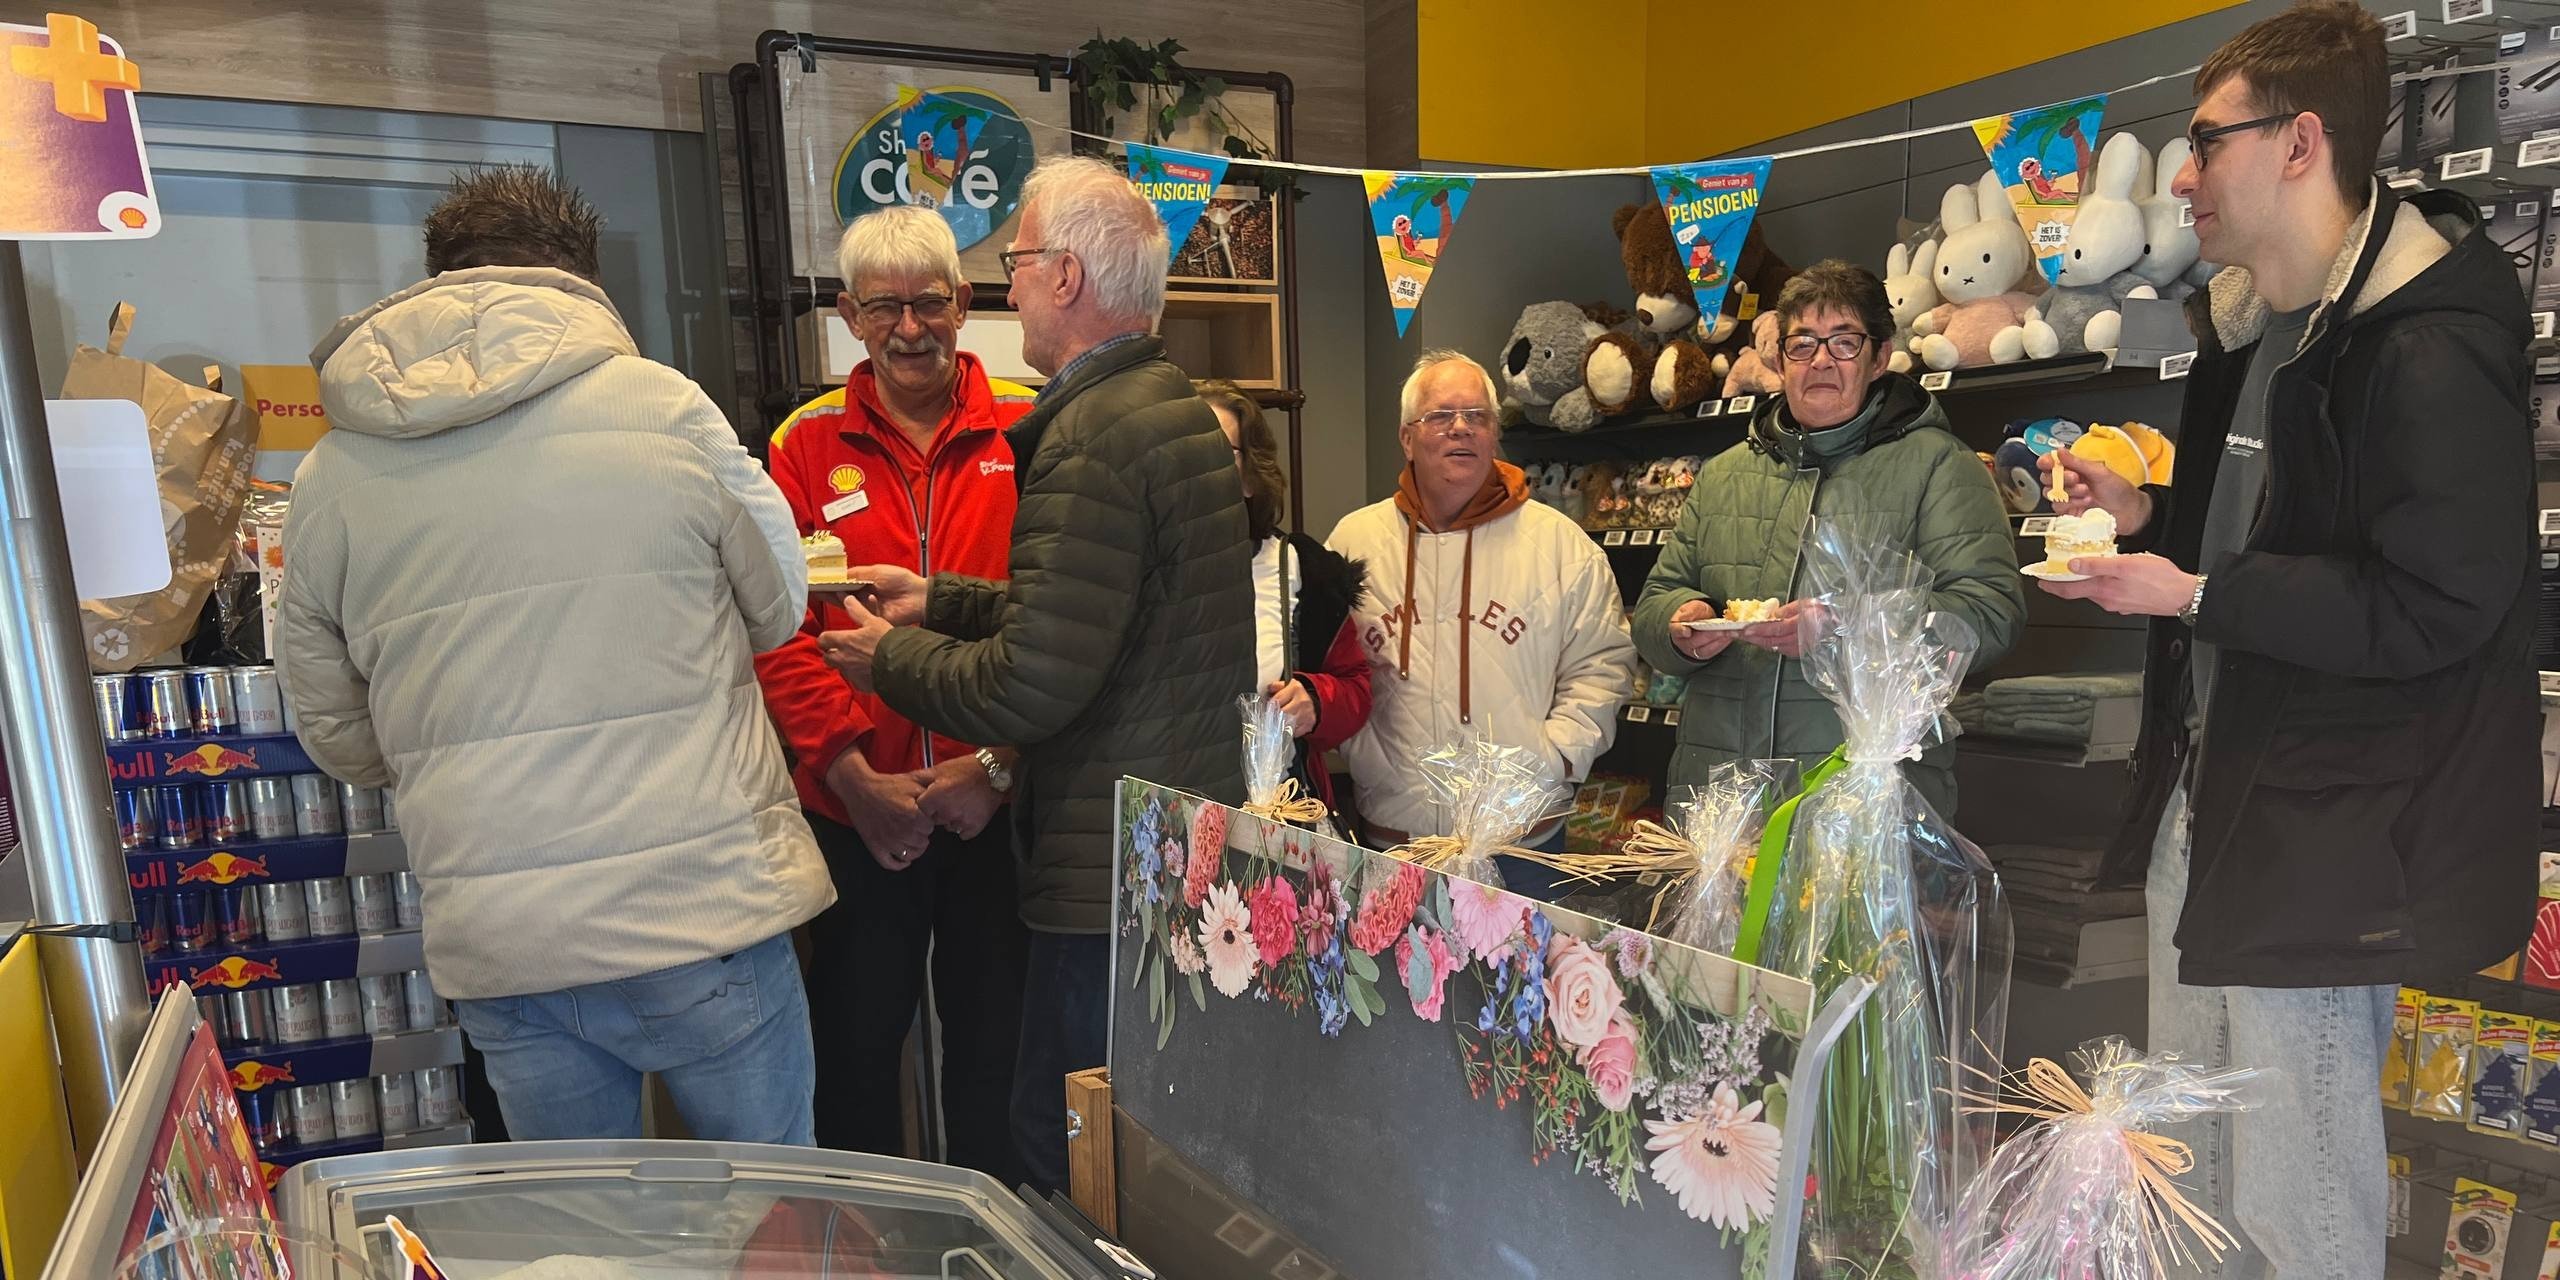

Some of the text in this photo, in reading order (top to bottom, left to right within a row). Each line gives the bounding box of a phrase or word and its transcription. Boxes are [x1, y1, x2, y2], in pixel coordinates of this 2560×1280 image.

[879, 129, 906, 155] Sh
[861, 148, 999, 210] cé
[1702, 178, 1748, 188] Geniet van je
[1669, 188, 1759, 226] PENSIOEN!
[2041, 226, 2061, 235] HET IS
[256, 399, 325, 418] Perso
[219, 438, 244, 468] kan
[107, 751, 155, 779] Bull
[130, 861, 167, 888] ull
[149, 966, 180, 994] ull
